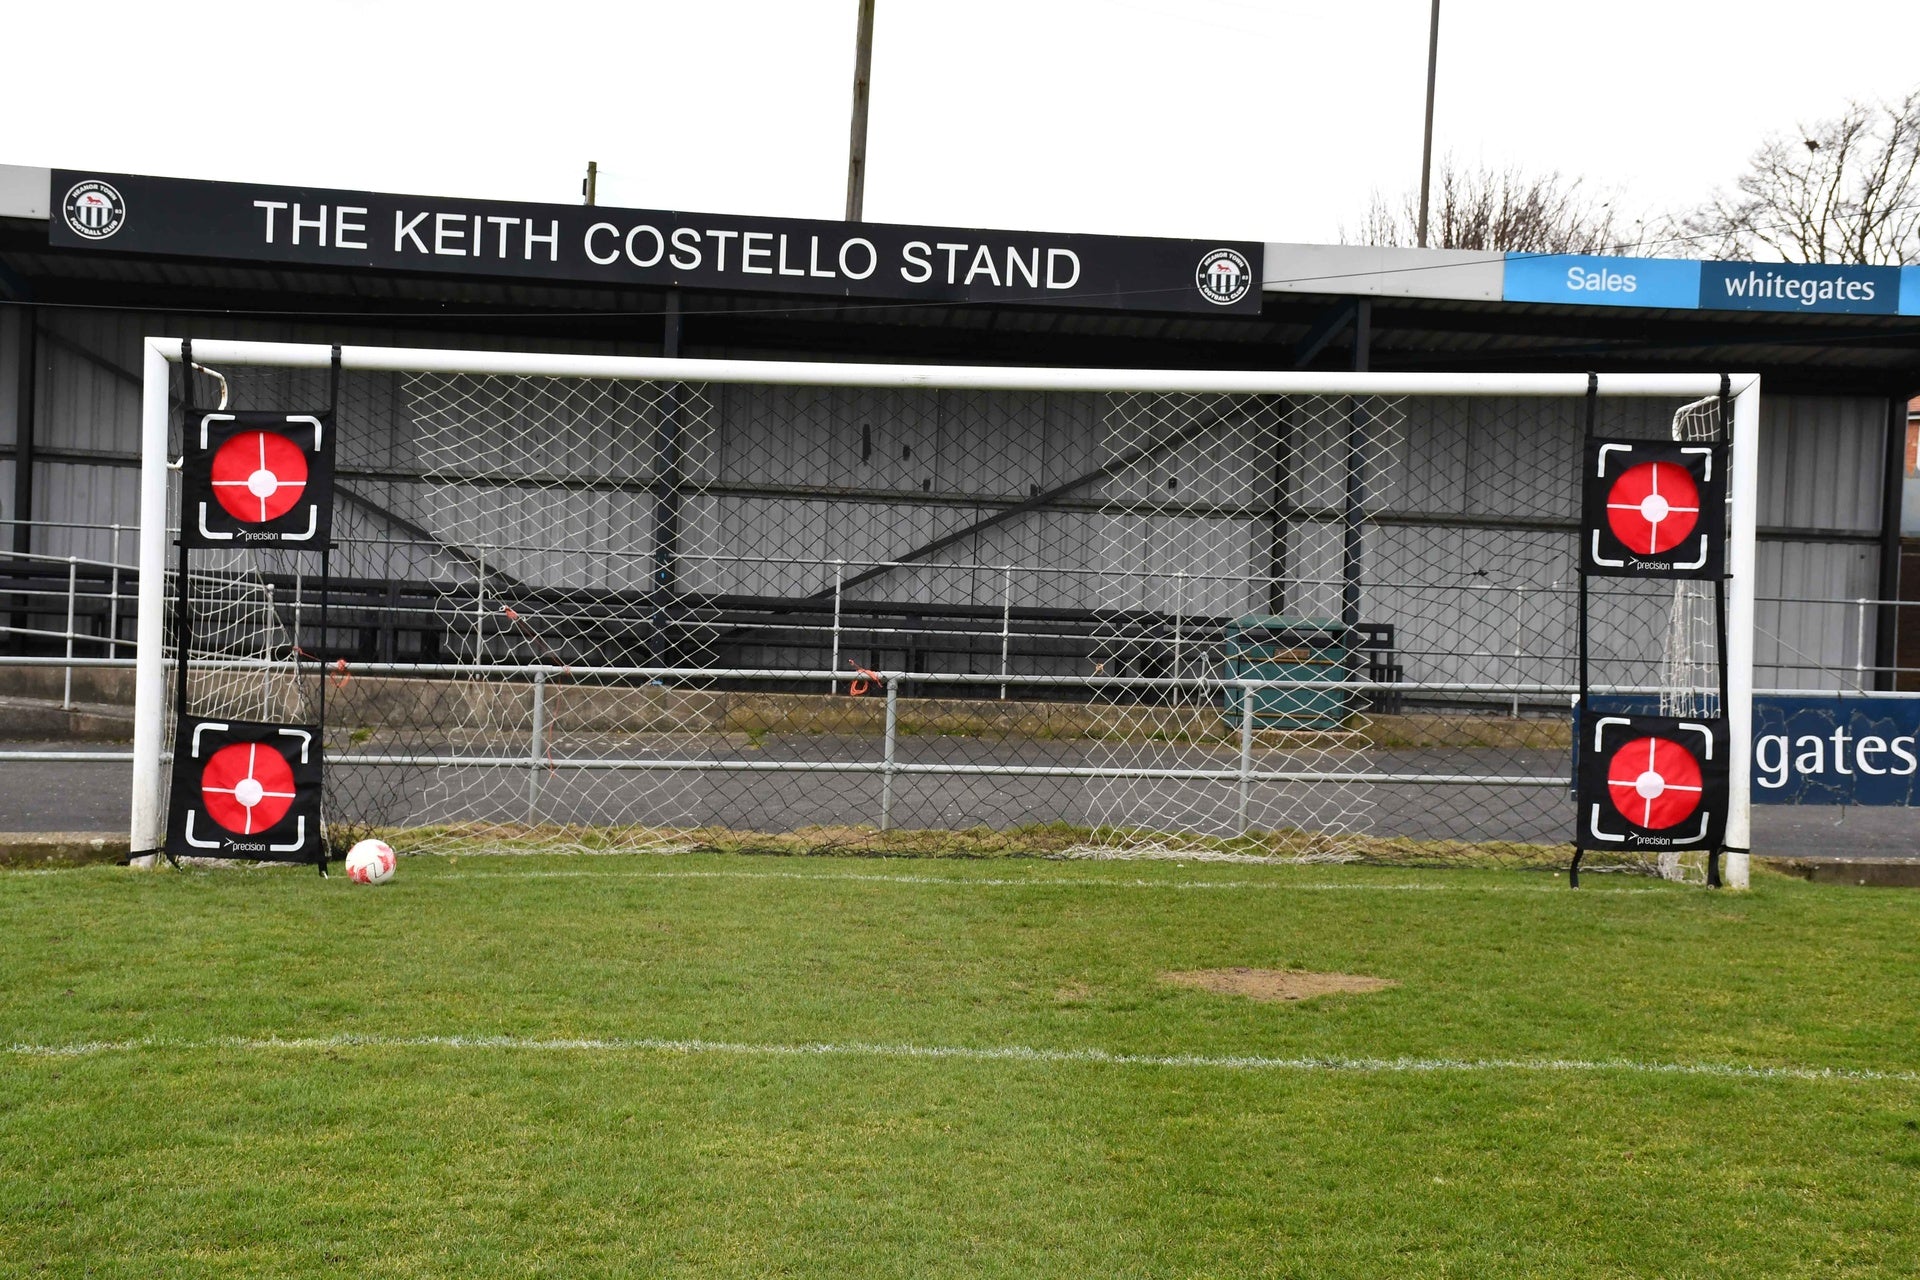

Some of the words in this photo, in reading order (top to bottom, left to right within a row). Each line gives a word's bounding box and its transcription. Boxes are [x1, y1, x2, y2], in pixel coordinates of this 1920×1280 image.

[100, 185, 117, 200] TOWN
[70, 217, 102, 236] FOOTBALL
[102, 220, 118, 234] CLUB
[254, 201, 367, 249] THE
[395, 211, 558, 261] KEITH
[585, 223, 877, 279] COSTELLO
[901, 242, 1080, 289] STAND
[1229, 253, 1245, 268] TOWN
[1566, 266, 1637, 293] Sales
[1202, 284, 1230, 301] FOOTBALL
[1230, 286, 1245, 299] CLUB
[1724, 271, 1876, 306] whitegates
[245, 531, 279, 542] precision
[1636, 560, 1671, 571] precision
[232, 842, 266, 852] precision
[1636, 836, 1671, 846] precision
